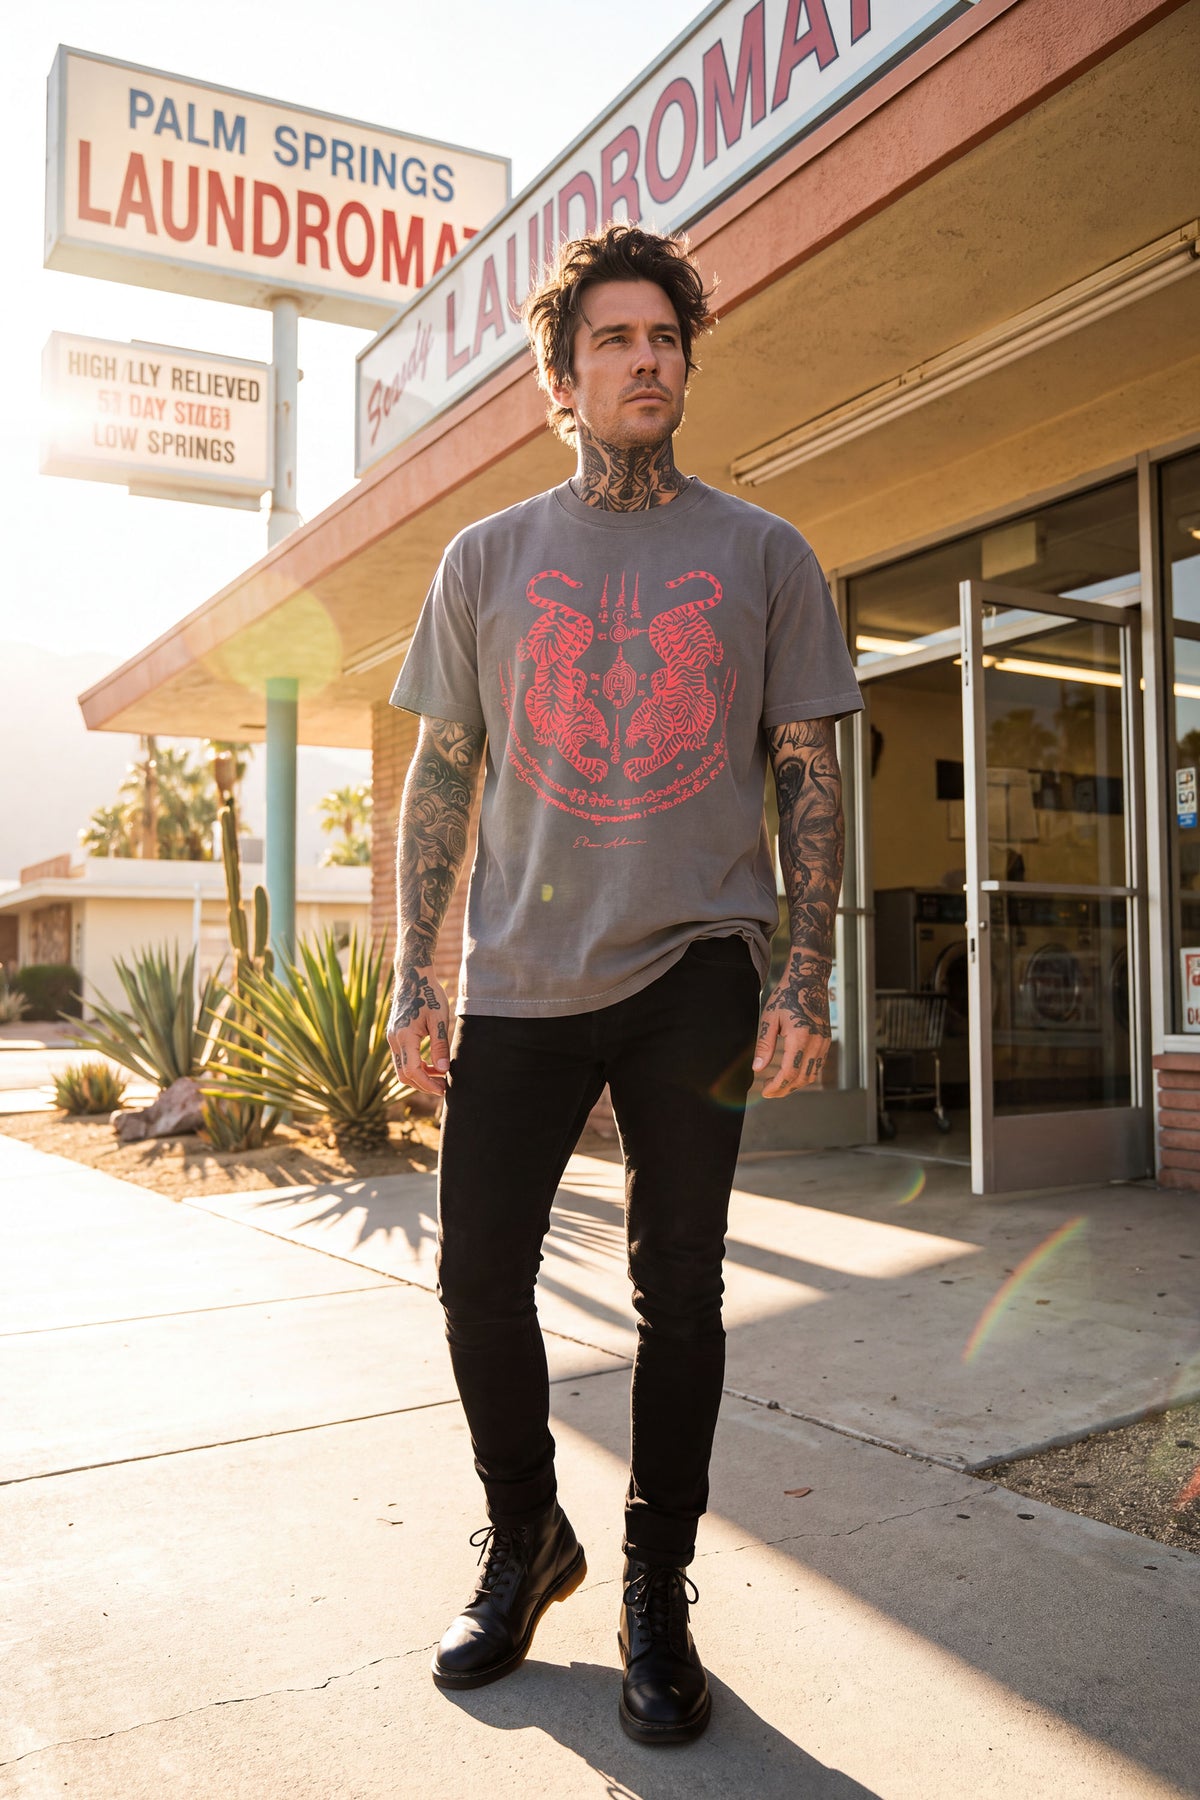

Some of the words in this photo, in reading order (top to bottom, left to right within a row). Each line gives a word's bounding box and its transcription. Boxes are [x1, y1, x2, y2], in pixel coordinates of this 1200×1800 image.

[129, 87, 246, 155] PALM
[274, 125, 455, 202] SPRINGS
[171, 368, 260, 403] RELIEVED
[130, 394, 167, 421] DAY
[148, 429, 236, 464] SPRINGS
